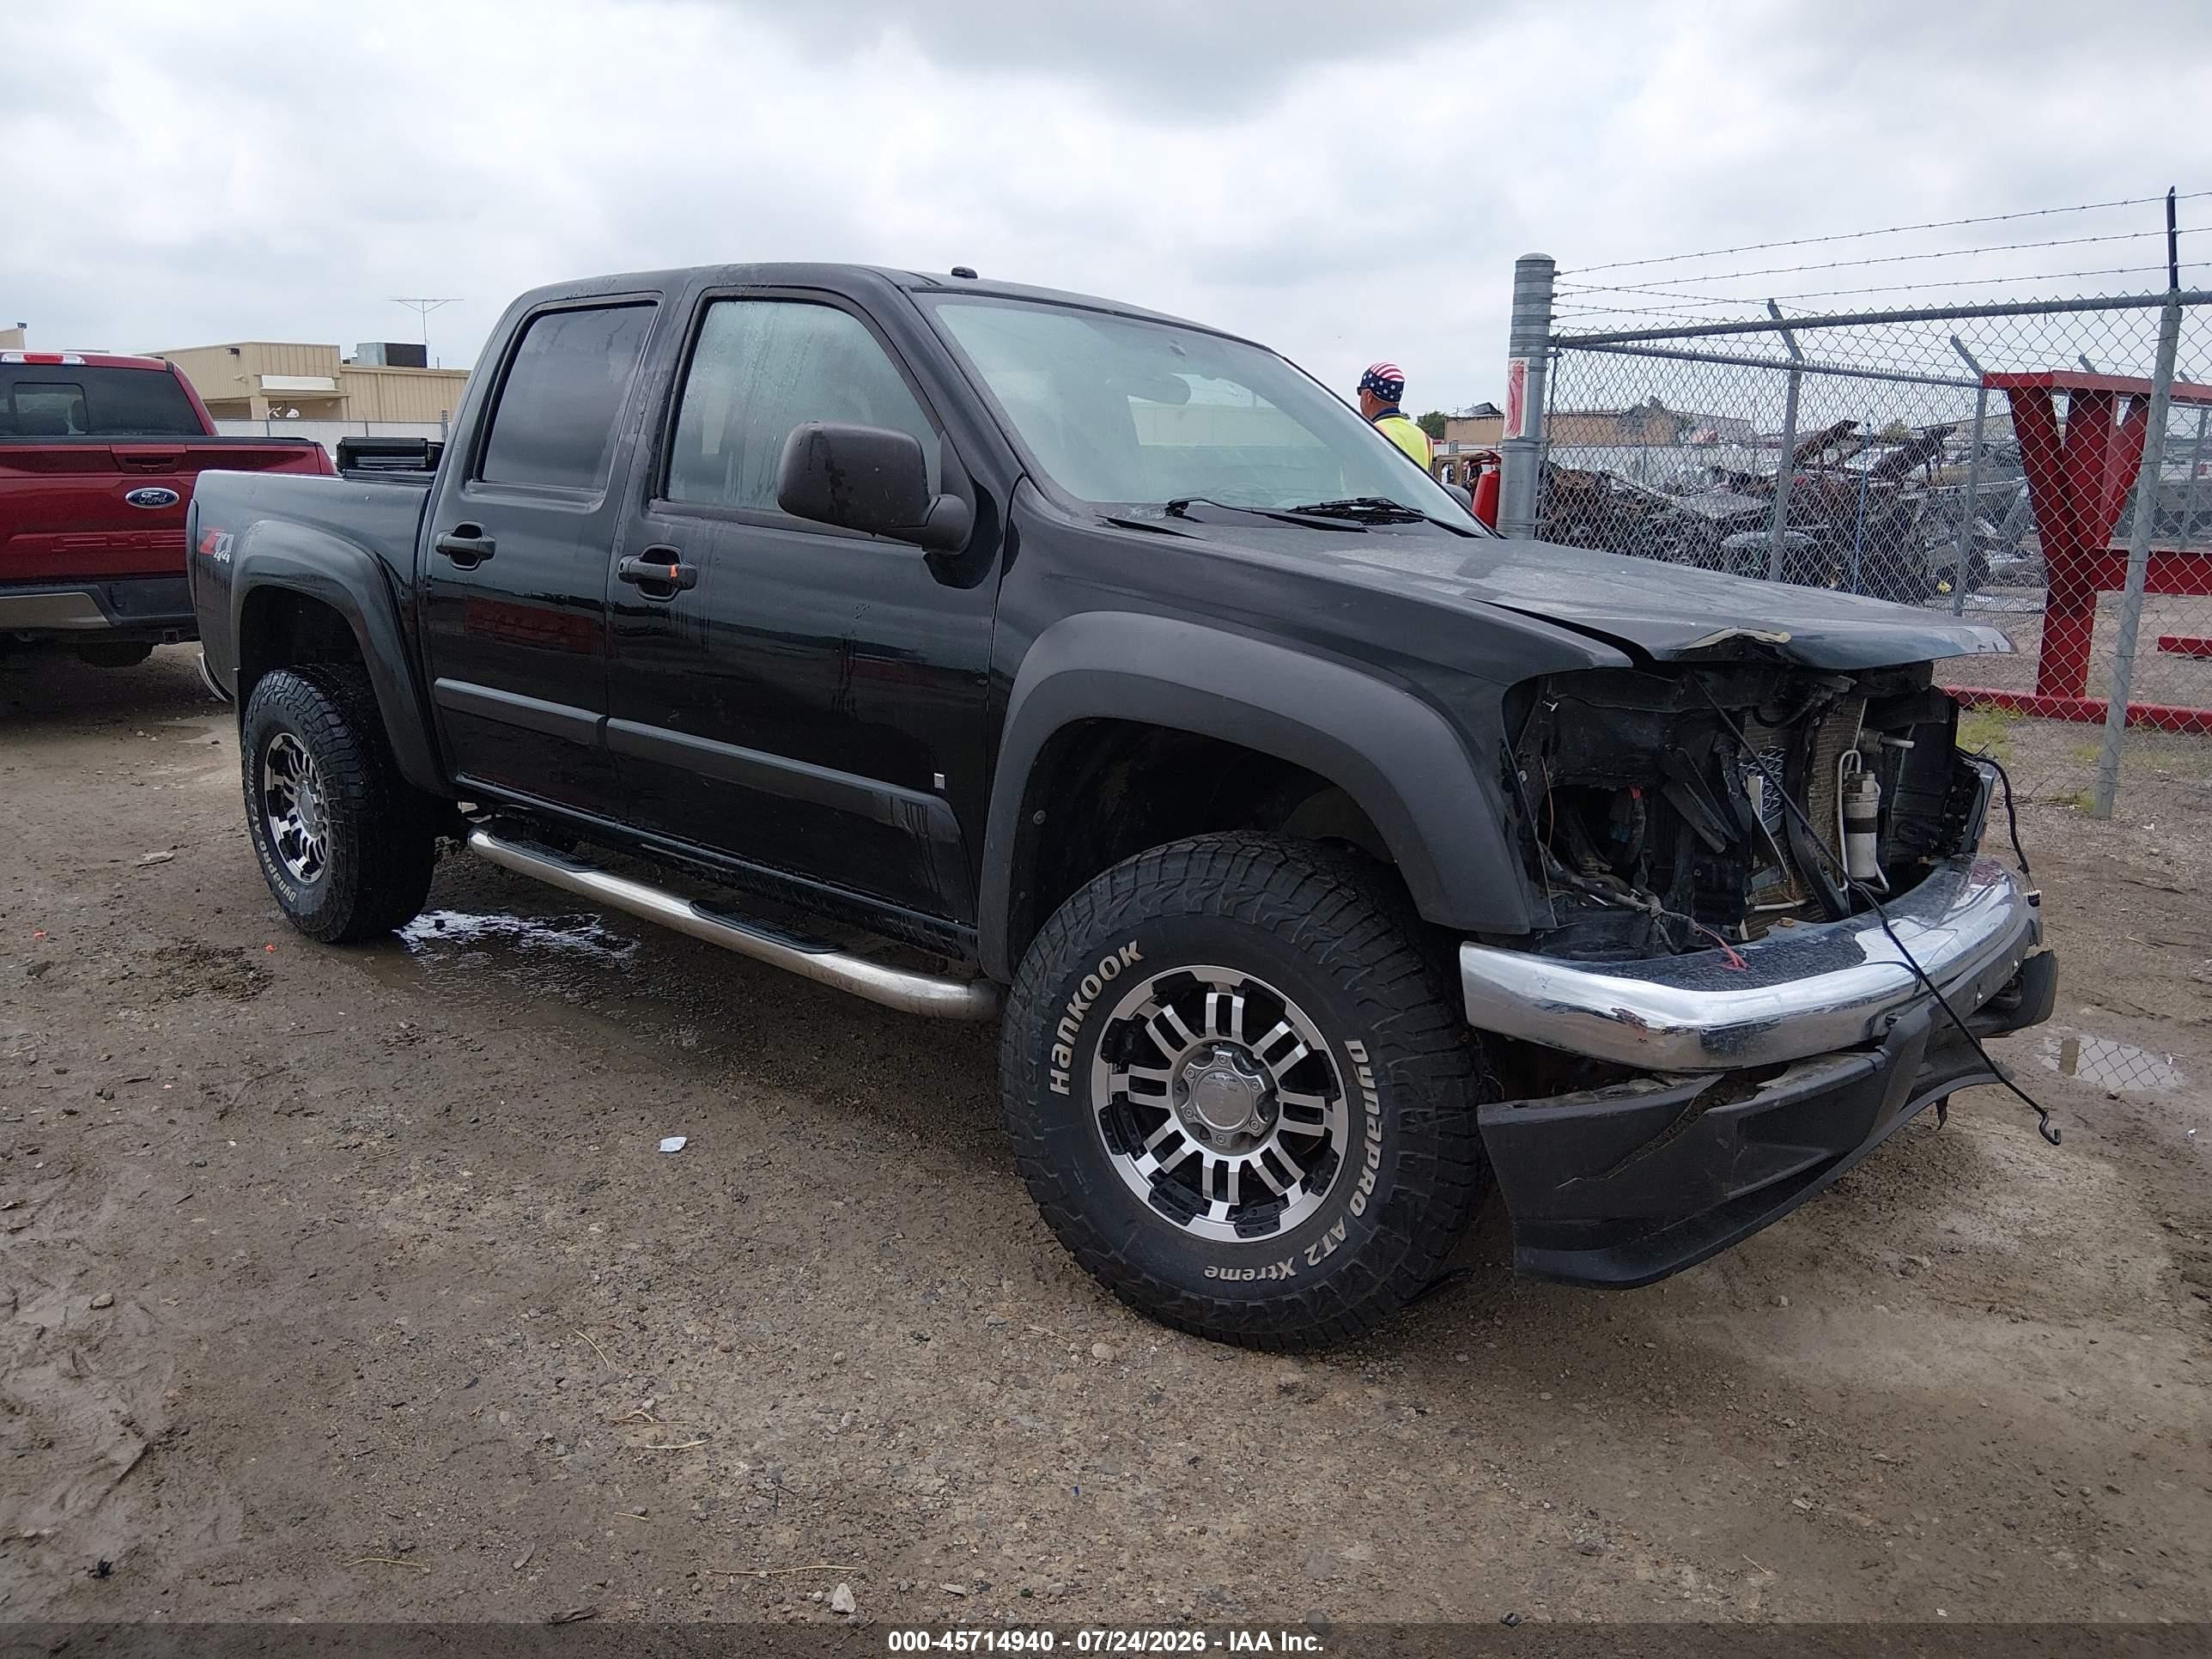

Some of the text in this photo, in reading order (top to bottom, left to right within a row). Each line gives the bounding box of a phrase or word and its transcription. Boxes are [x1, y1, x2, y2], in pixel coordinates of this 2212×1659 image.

[199, 527, 234, 555] Z71
[247, 749, 256, 797] Xtreme
[250, 803, 262, 834] AT2
[1304, 1216, 1347, 1267] AT2
[1204, 1256, 1297, 1281] Xtreme
